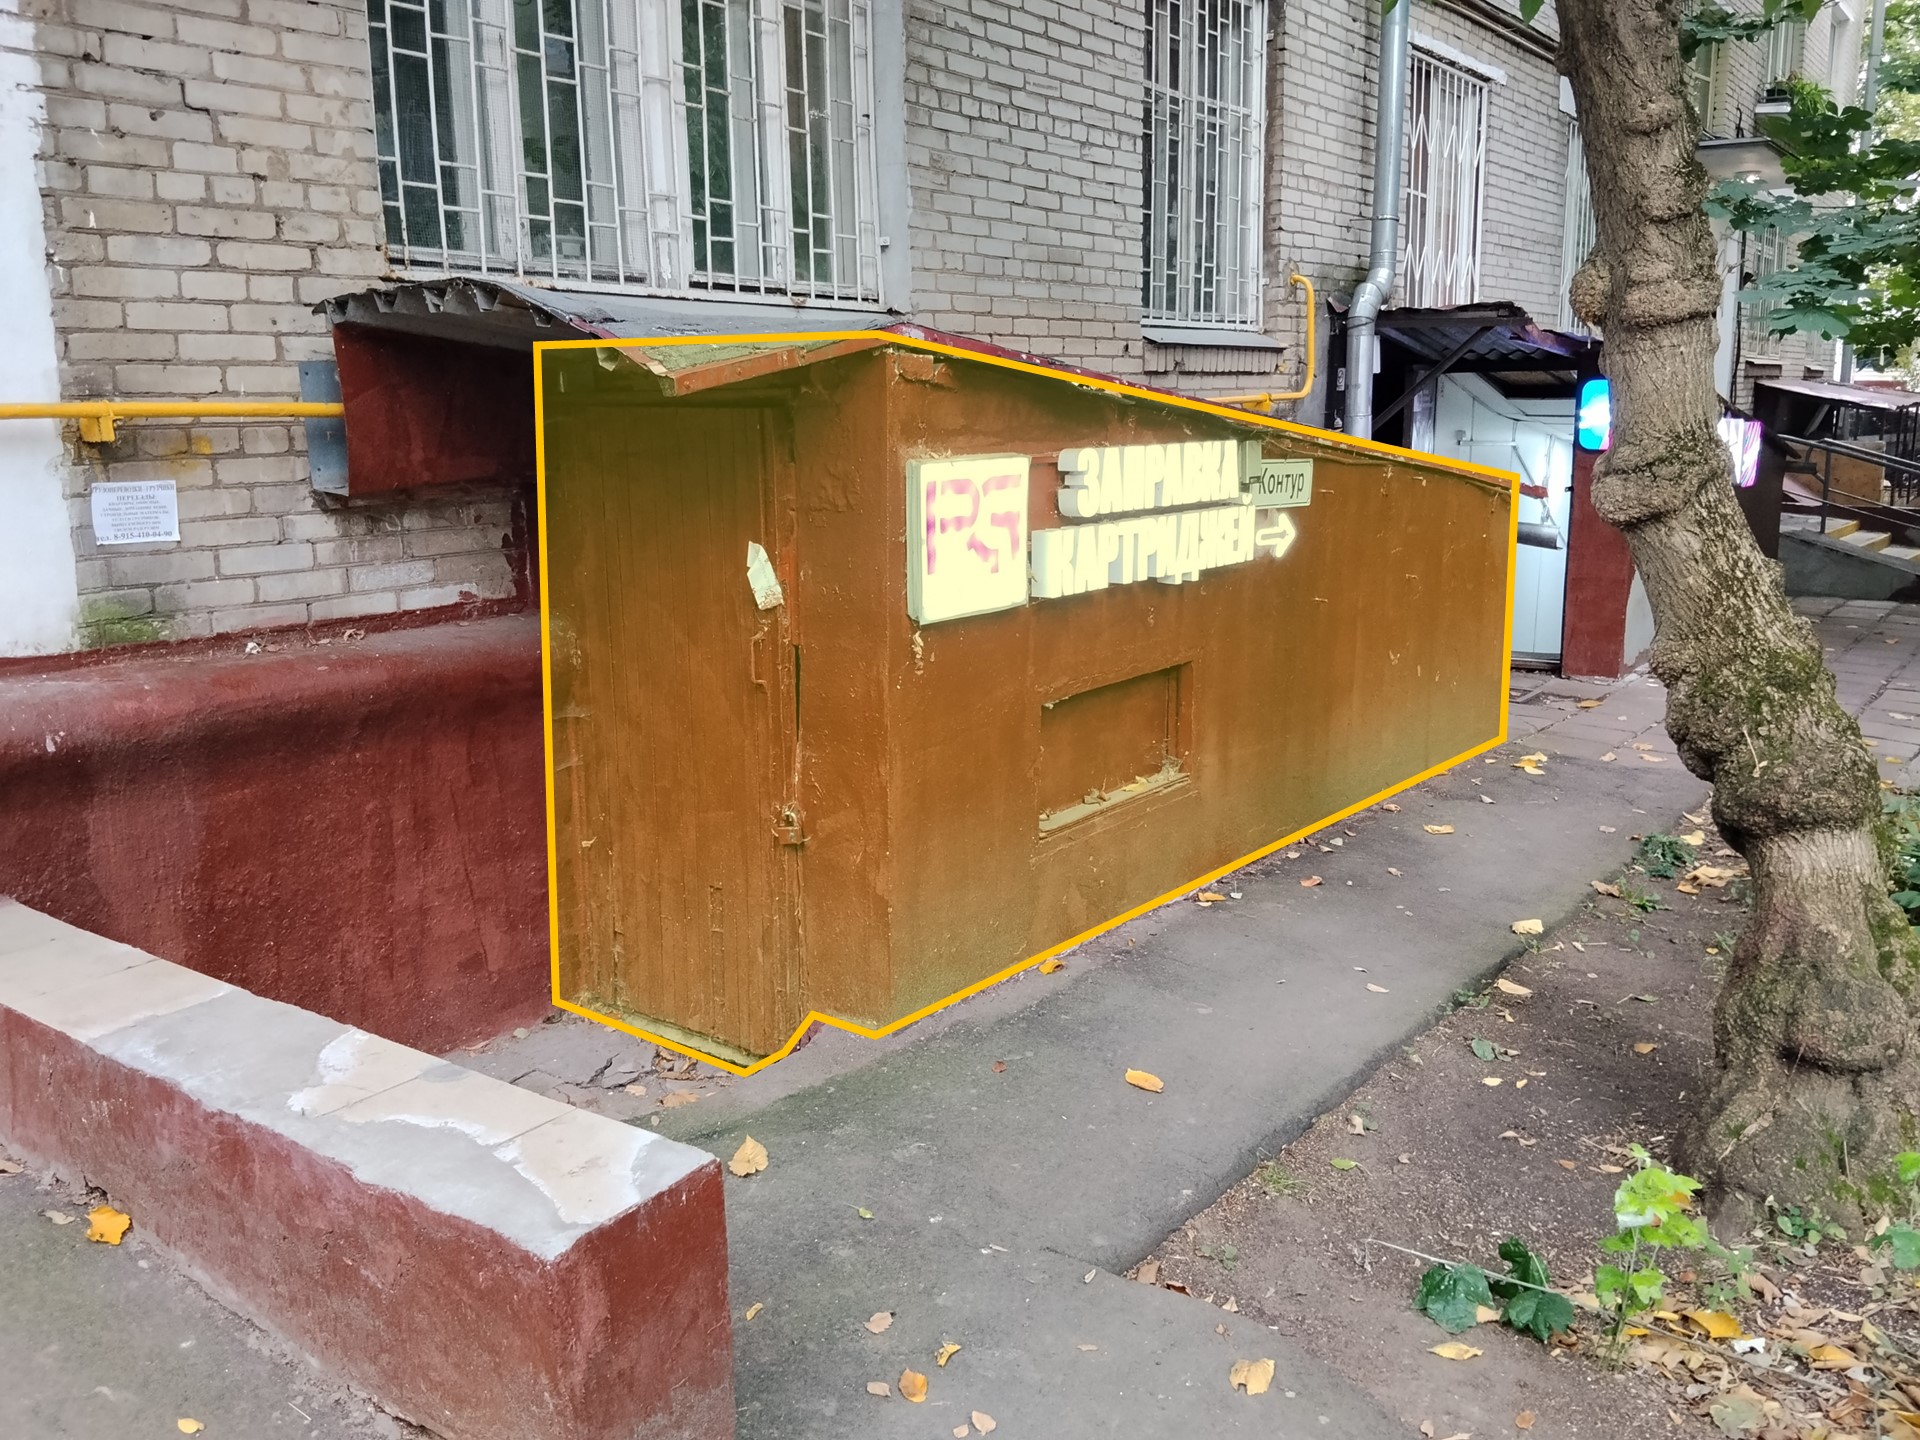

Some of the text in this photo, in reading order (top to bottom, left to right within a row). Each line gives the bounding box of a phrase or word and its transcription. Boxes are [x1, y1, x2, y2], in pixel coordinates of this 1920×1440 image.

[1058, 440, 1240, 518] ЗАПРАВКА
[1258, 467, 1305, 500] Контур
[1031, 493, 1256, 599] КАРТРИДЖЕЙ
